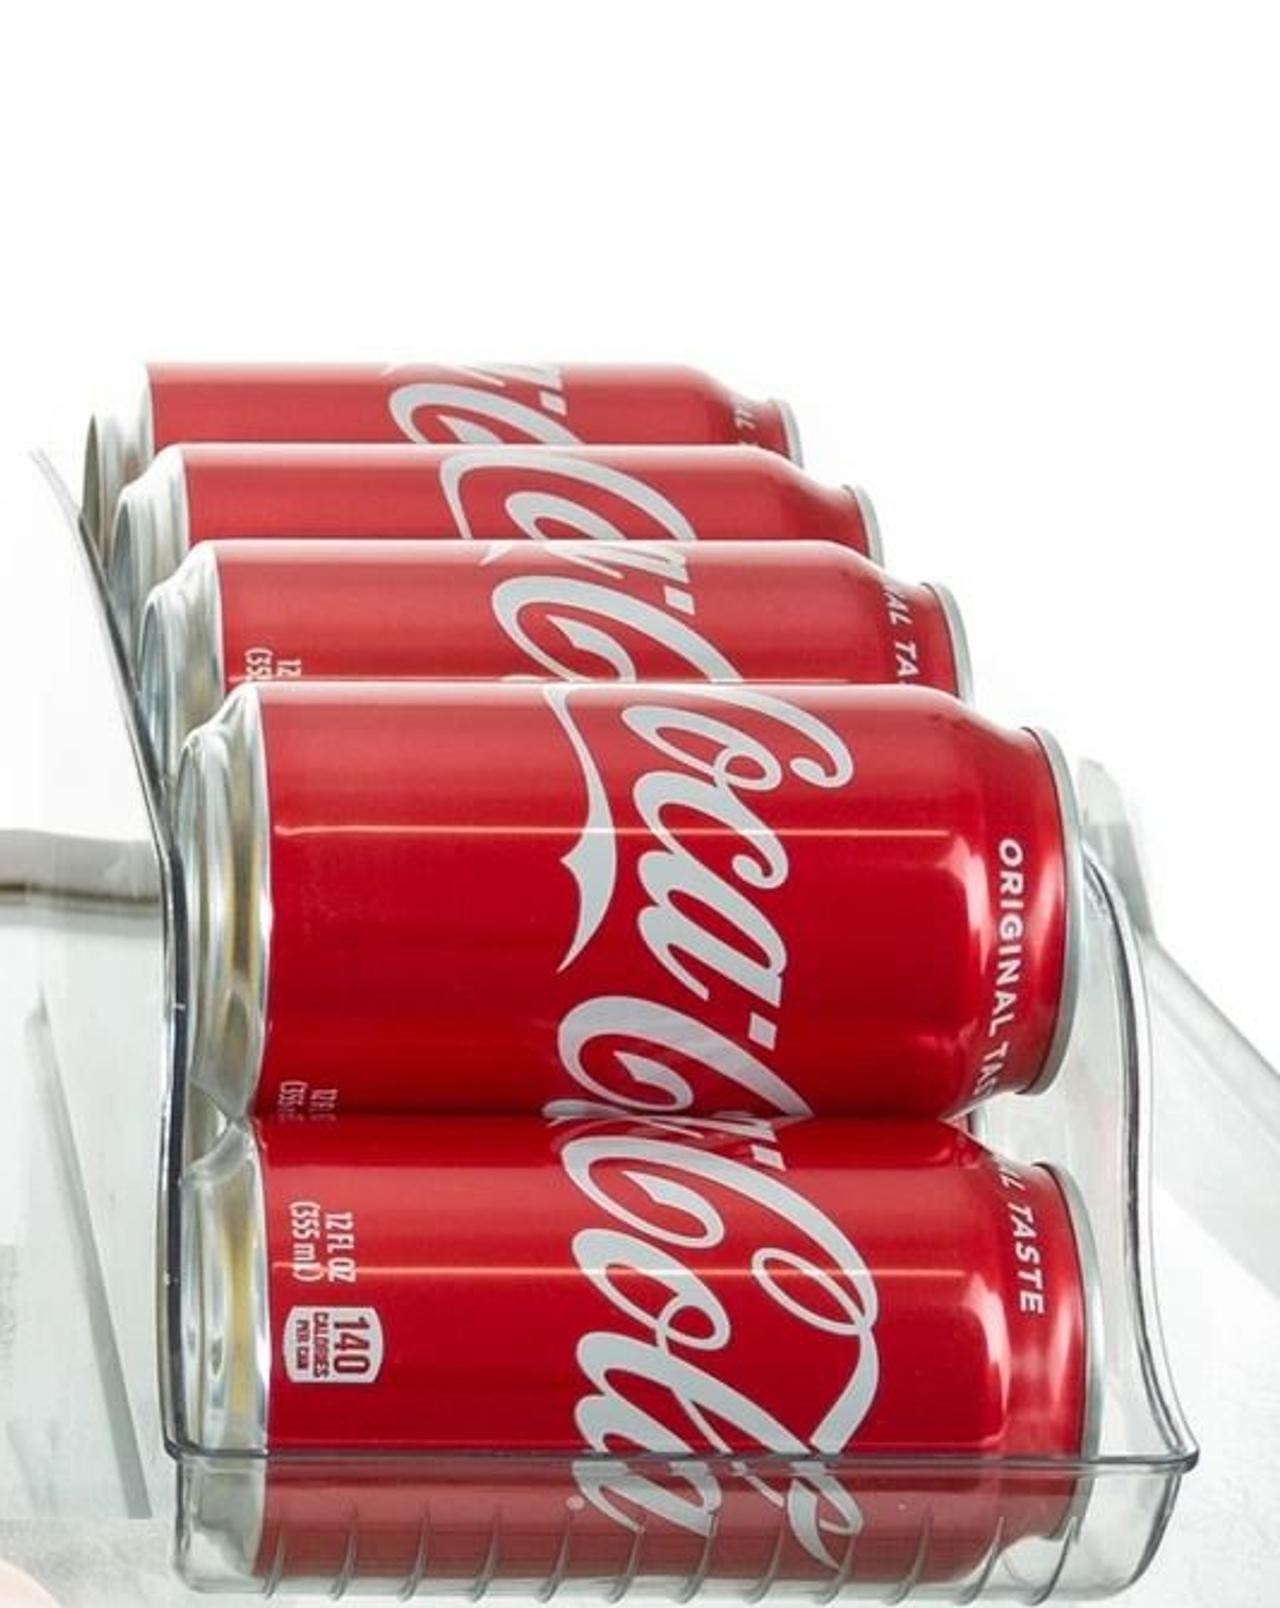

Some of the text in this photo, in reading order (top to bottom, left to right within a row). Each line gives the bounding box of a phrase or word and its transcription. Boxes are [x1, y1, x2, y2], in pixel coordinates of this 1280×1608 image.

[988, 837, 1025, 1038] ORIGINAL
[325, 1211, 357, 1283] 12 FL OZ
[1007, 1201, 1045, 1314] TASTE
[313, 1311, 330, 1379] CALORIES
[333, 1316, 371, 1374] 140
